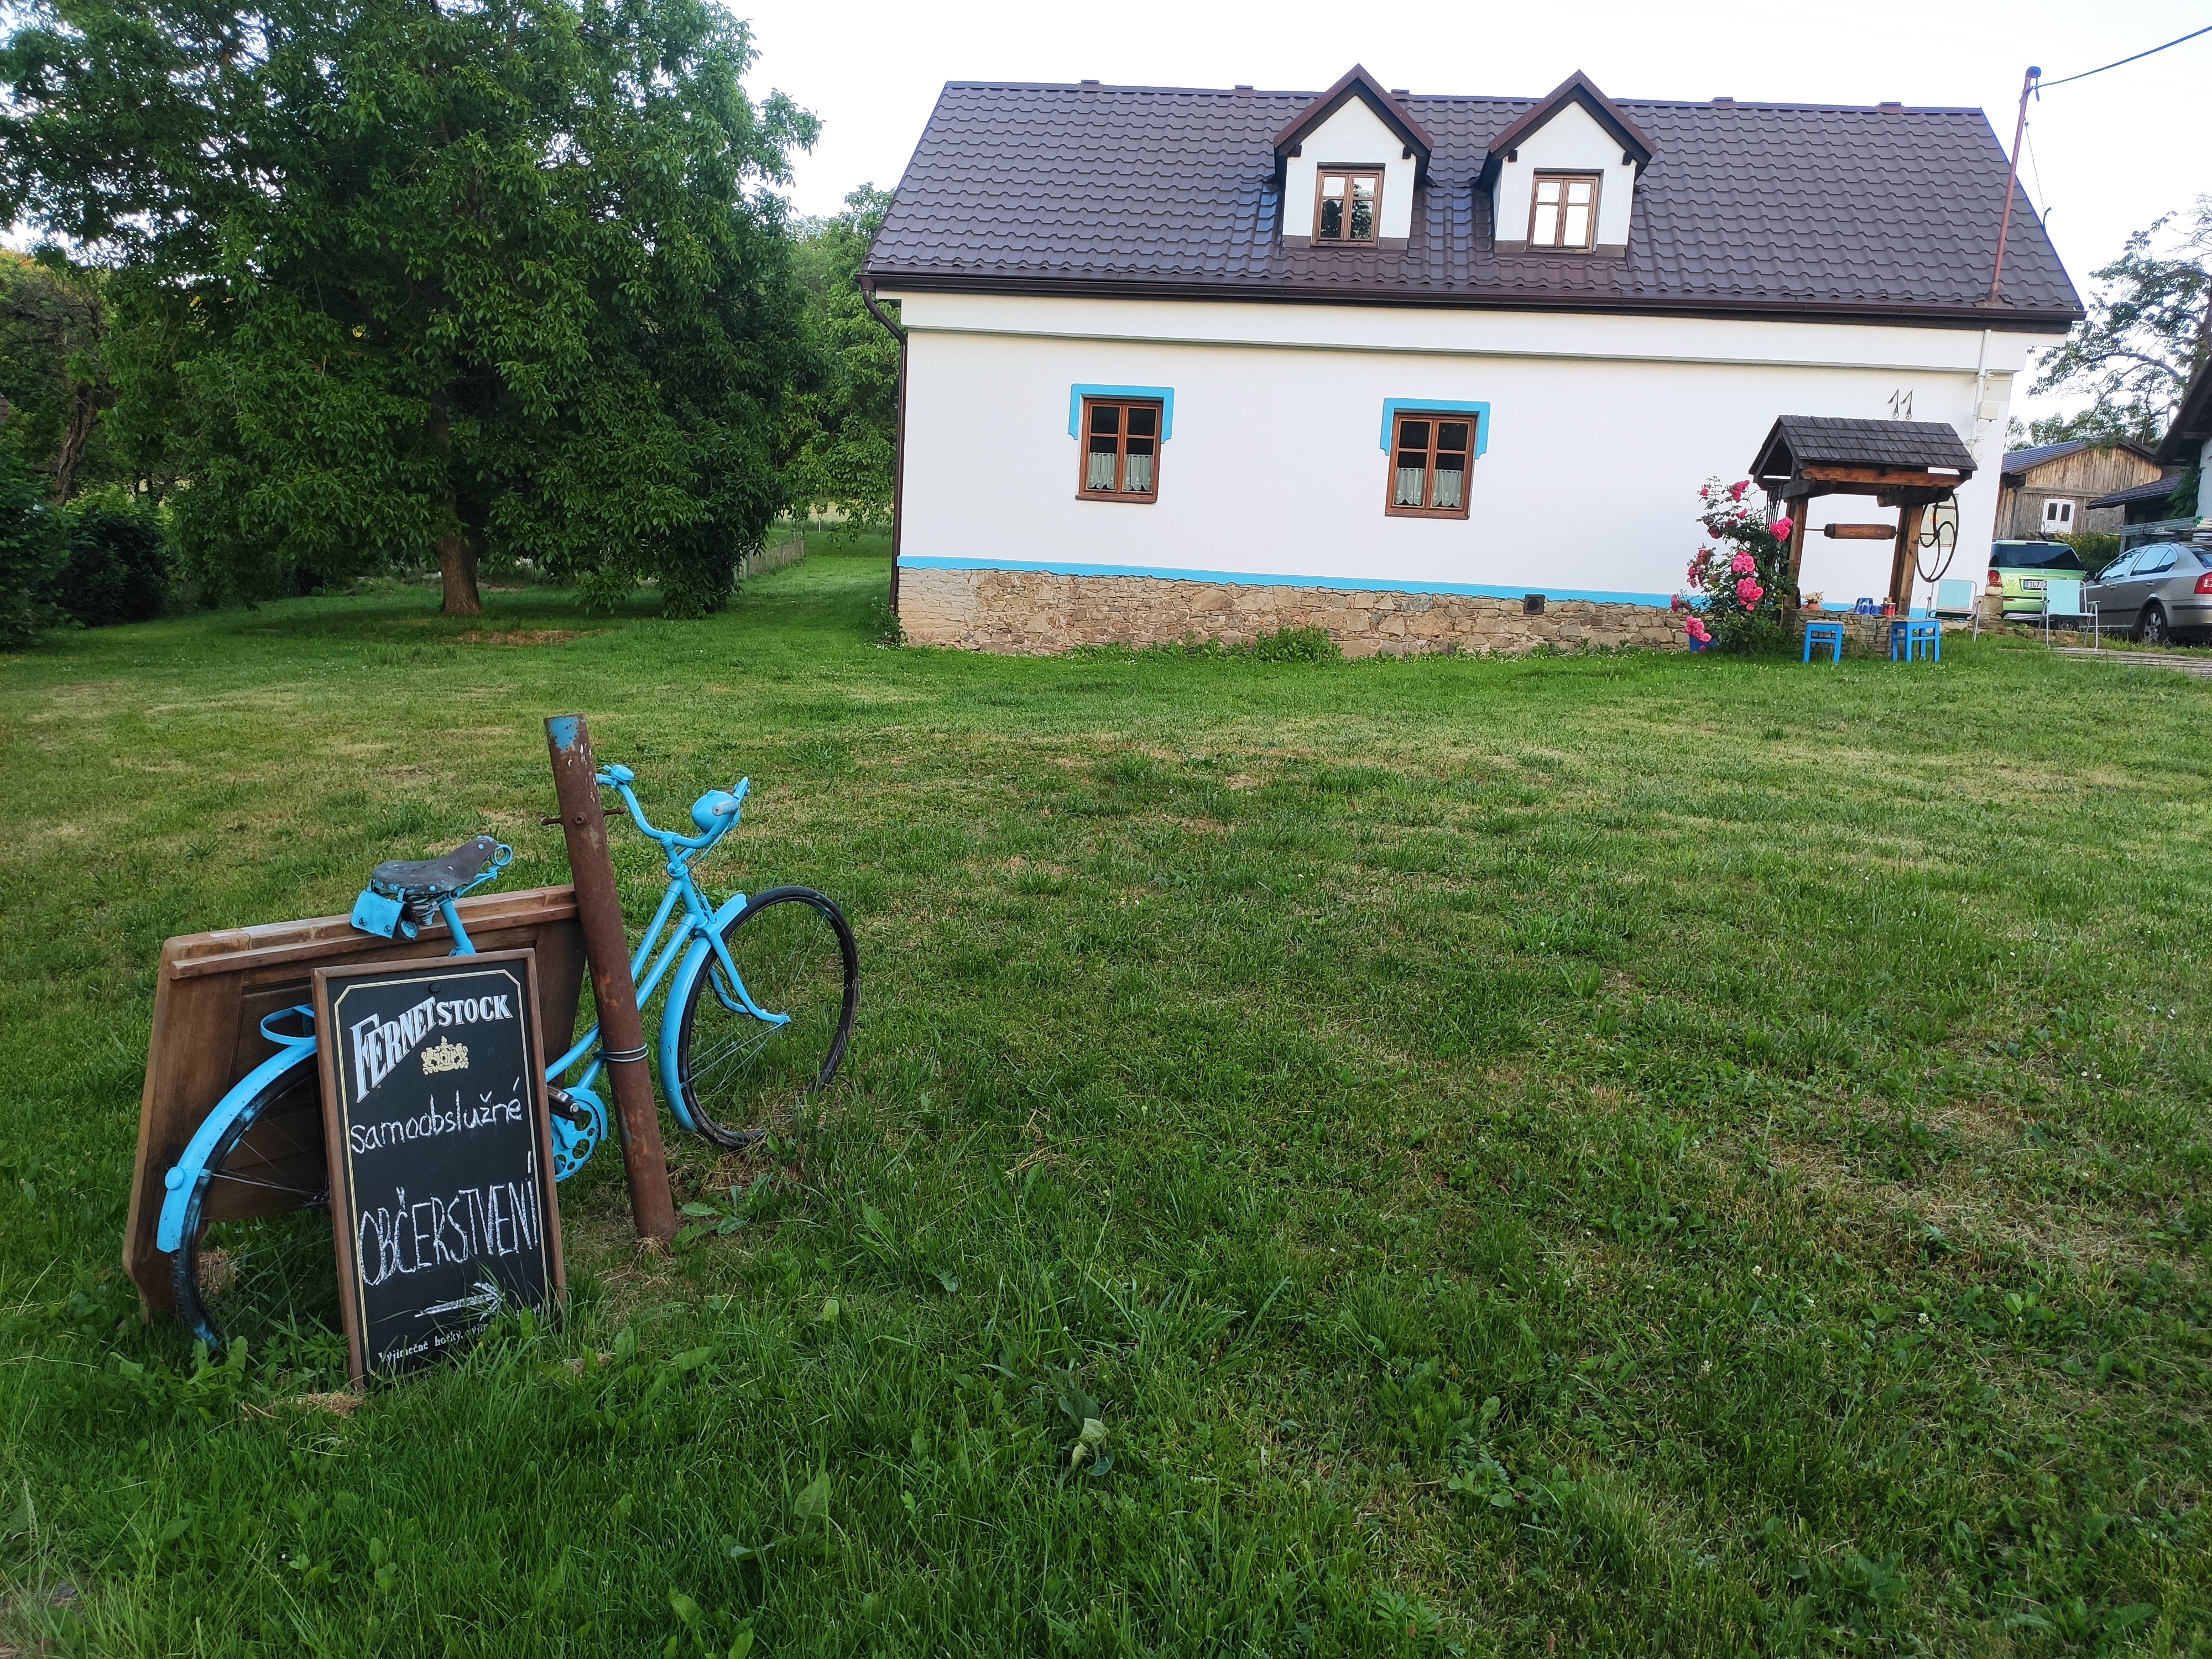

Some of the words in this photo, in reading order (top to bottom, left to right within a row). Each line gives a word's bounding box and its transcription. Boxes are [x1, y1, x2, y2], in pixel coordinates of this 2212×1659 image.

[1887, 388, 1913, 420] 11
[350, 997, 436, 1103] FERNET
[436, 994, 514, 1027] STOCK
[351, 1077, 523, 1154] samoobslužné
[359, 1151, 538, 1286] OBČERSTVENÍ
